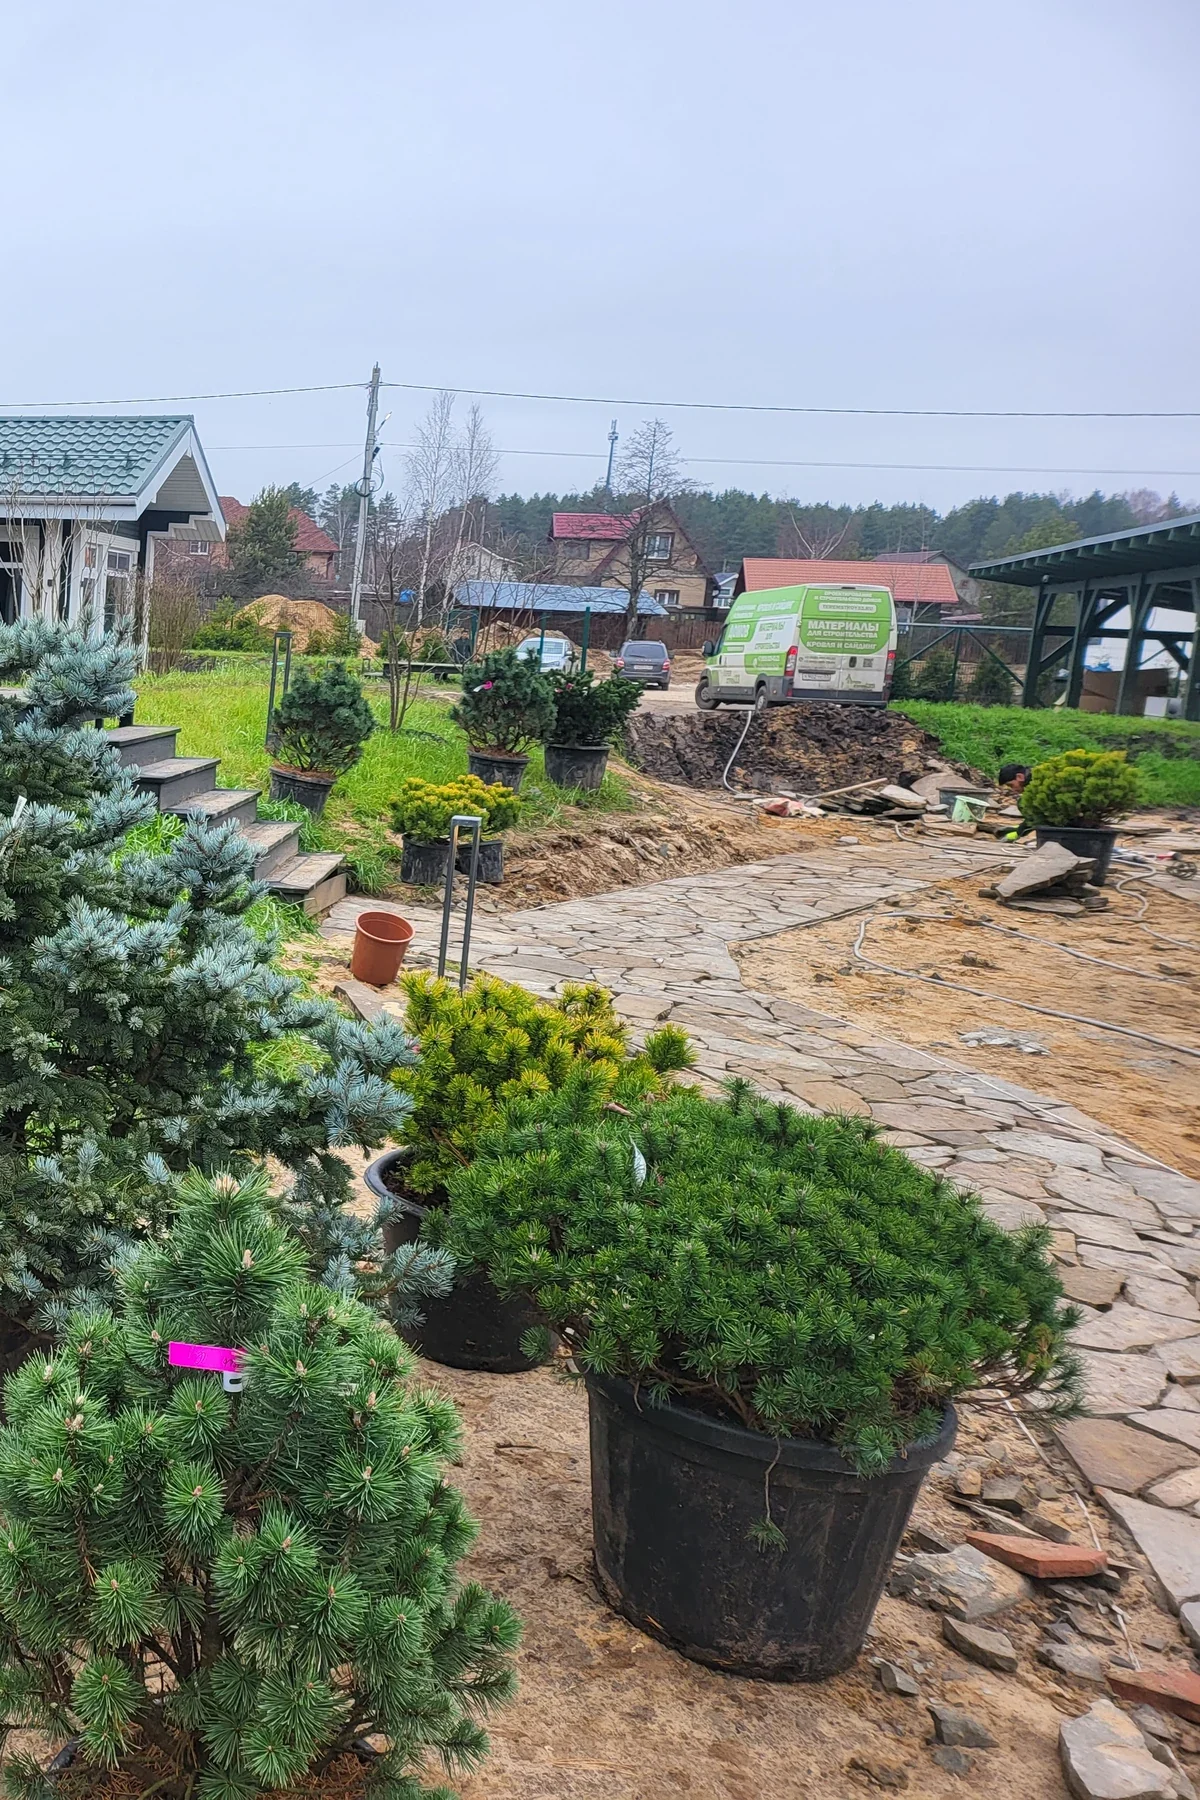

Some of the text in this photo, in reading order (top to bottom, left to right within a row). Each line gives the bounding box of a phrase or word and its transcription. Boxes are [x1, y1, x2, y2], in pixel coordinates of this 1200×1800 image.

[808, 620, 879, 632] МАТЕРИАЛЫ
[823, 630, 878, 638] СТРОИТЕЛЬСТВА
[844, 642, 877, 650] САЙДИНГ
